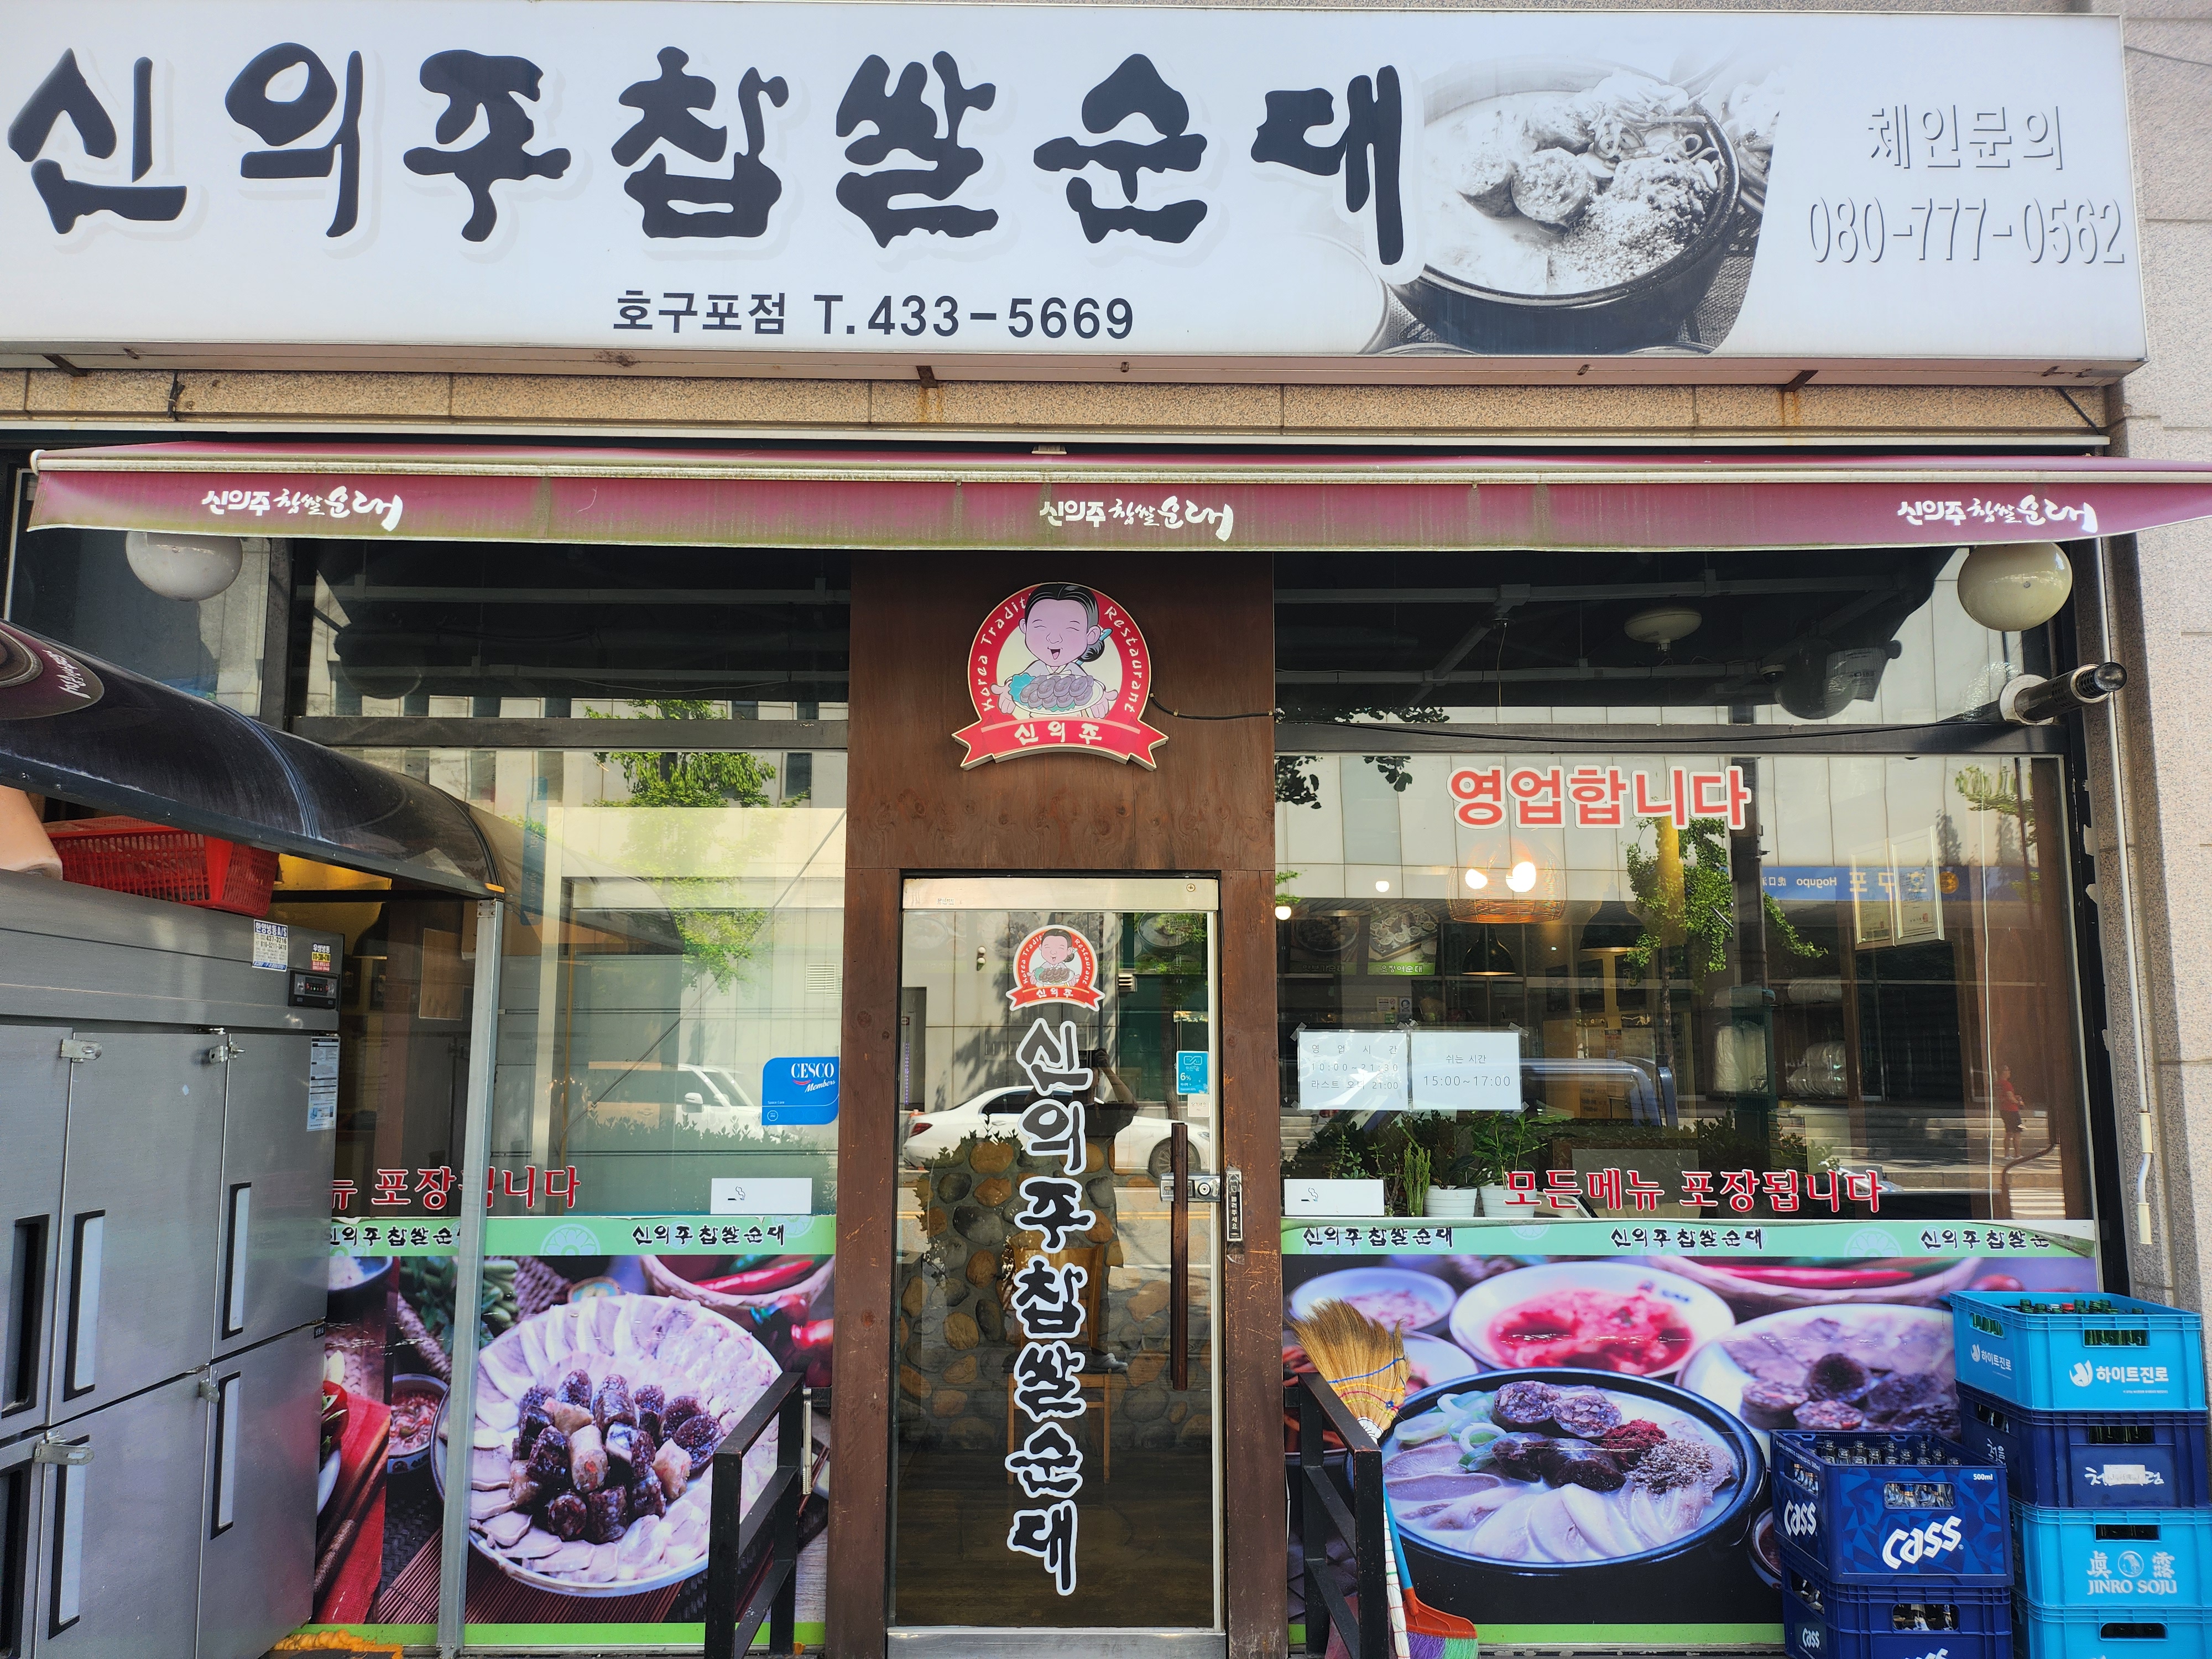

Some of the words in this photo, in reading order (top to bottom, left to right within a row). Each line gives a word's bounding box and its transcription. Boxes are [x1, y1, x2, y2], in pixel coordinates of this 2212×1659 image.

[1868, 104, 2063, 170] 체인문의
[8, 42, 1404, 265] 신의주찹쌀순대
[1810, 196, 2125, 264] 080-777-0562
[613, 289, 786, 335] 호구포점
[815, 293, 1134, 339] T.433-5669
[202, 490, 270, 516] 신의주
[1040, 501, 1106, 528] 신의주
[1897, 500, 1966, 526] 신의주
[980, 596, 1029, 645] Tradit
[1104, 606, 1143, 713] Restaurant
[1014, 721, 1102, 745] 신의주
[1448, 766, 1750, 828] 영업합니다
[1036, 987, 1073, 998] 신의주
[791, 1062, 834, 1079] CESCO
[1446, 1055, 1464, 1064] 쉬는
[1468, 1055, 1486, 1065] 시간
[804, 1078, 836, 1093] Members
[1180, 1072, 1192, 1081] 6%
[1311, 1079, 1340, 1089] 라스트
[1423, 1075, 1511, 1087] 15:00~17:00
[1504, 1167, 1665, 1212] 모든메뉴
[1679, 1168, 1883, 1213] 포장됩니다
[632, 1224, 785, 1246] 신의주찹쌀순대
[1302, 1226, 1453, 1249] 신의주찹쌀순대
[1610, 1227, 1764, 1250] 신의주찹쌀순대
[1008, 1021, 1094, 1593] 신의주찹쌀순대
[1981, 1349, 2012, 1371] 하이트진로
[2095, 1365, 2169, 1384] 하이트진로
[2086, 1579, 2134, 1595] JINRO
[2137, 1579, 2178, 1595] SOJU
